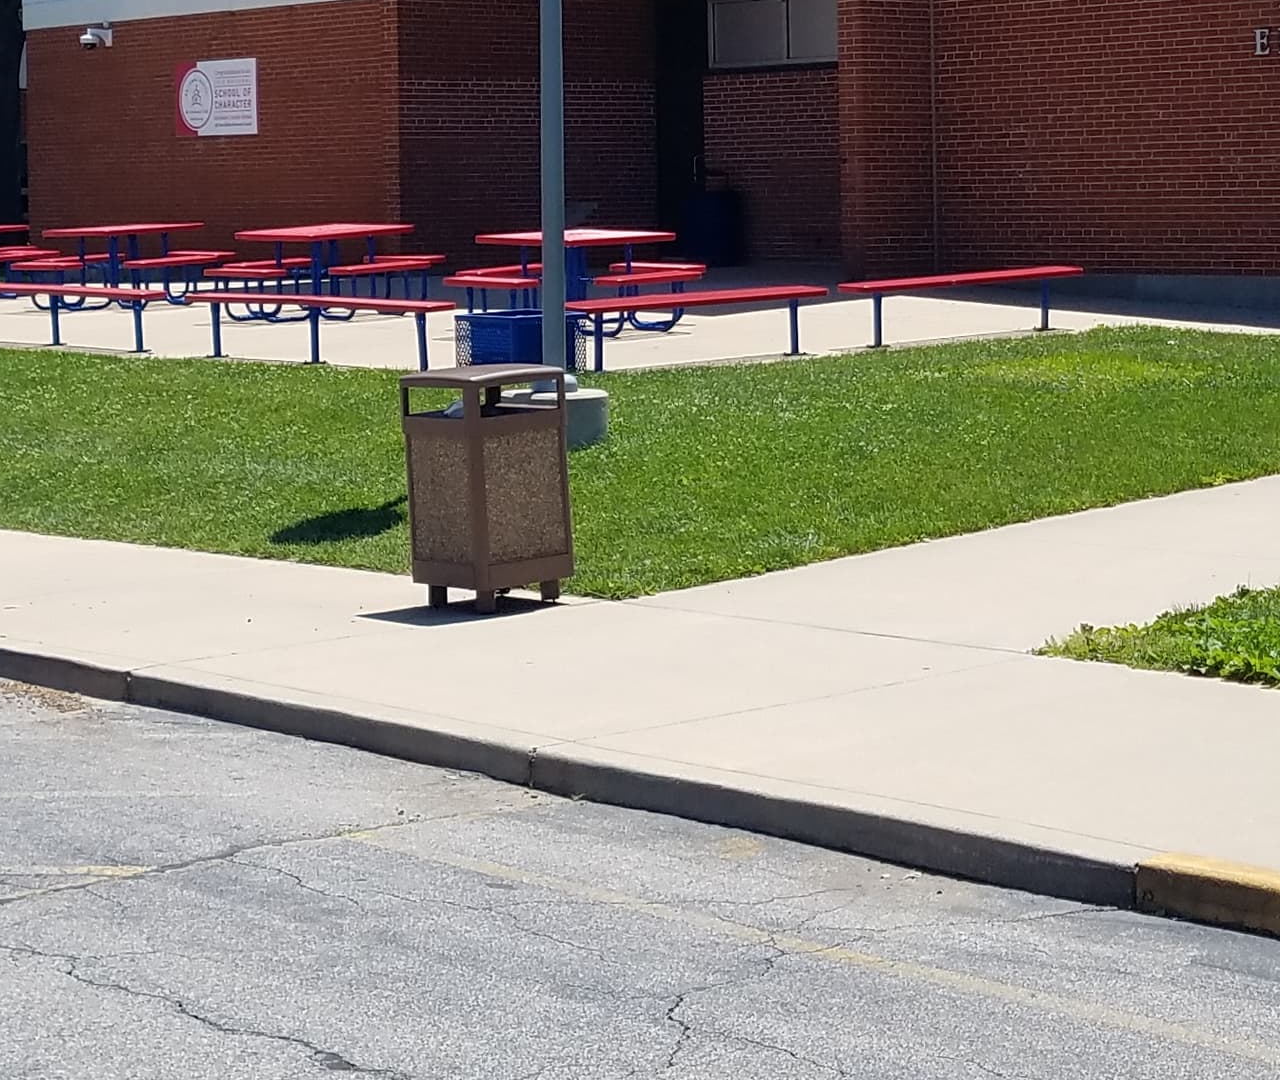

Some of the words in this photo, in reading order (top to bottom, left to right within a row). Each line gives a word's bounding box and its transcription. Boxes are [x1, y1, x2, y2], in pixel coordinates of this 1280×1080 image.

[214, 88, 241, 98] SCHOOL
[243, 87, 252, 97] OF
[214, 99, 252, 110] CHARACTER
